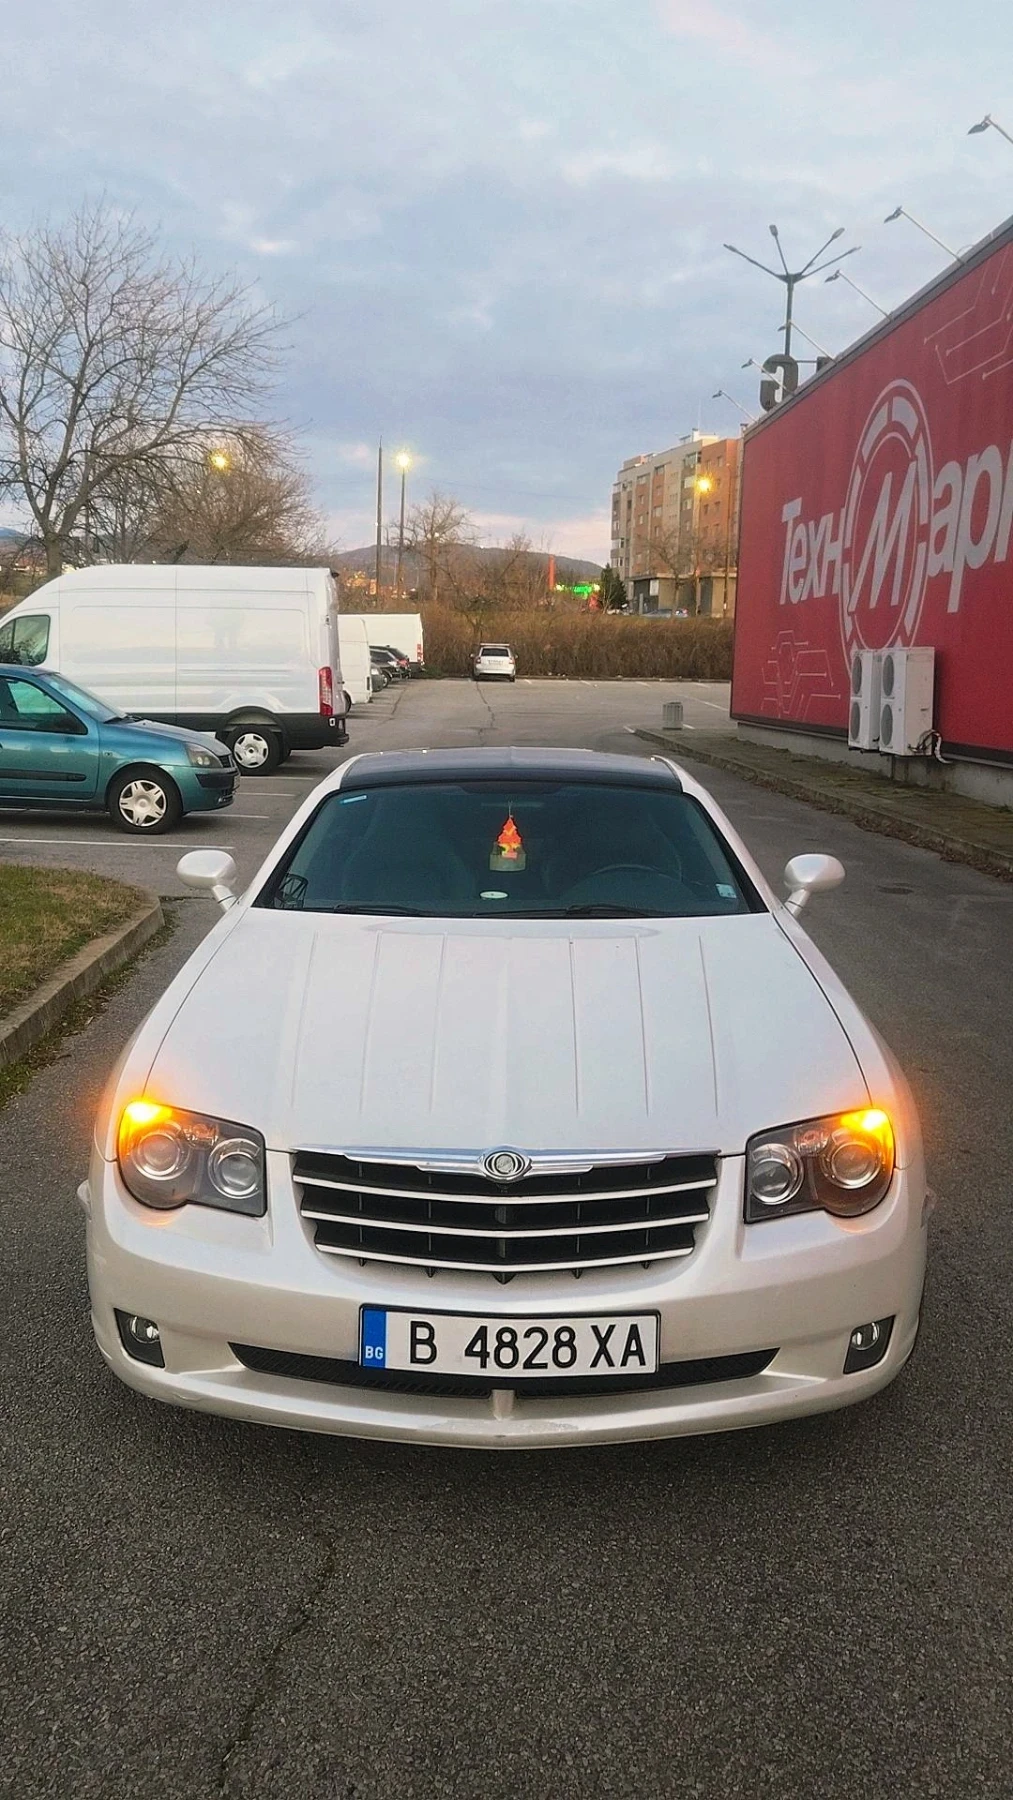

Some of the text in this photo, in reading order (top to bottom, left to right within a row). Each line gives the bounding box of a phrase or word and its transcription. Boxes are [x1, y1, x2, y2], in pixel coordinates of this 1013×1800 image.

[365, 1345, 383, 1360] BG
[409, 1320, 646, 1370] B 4828 XA
